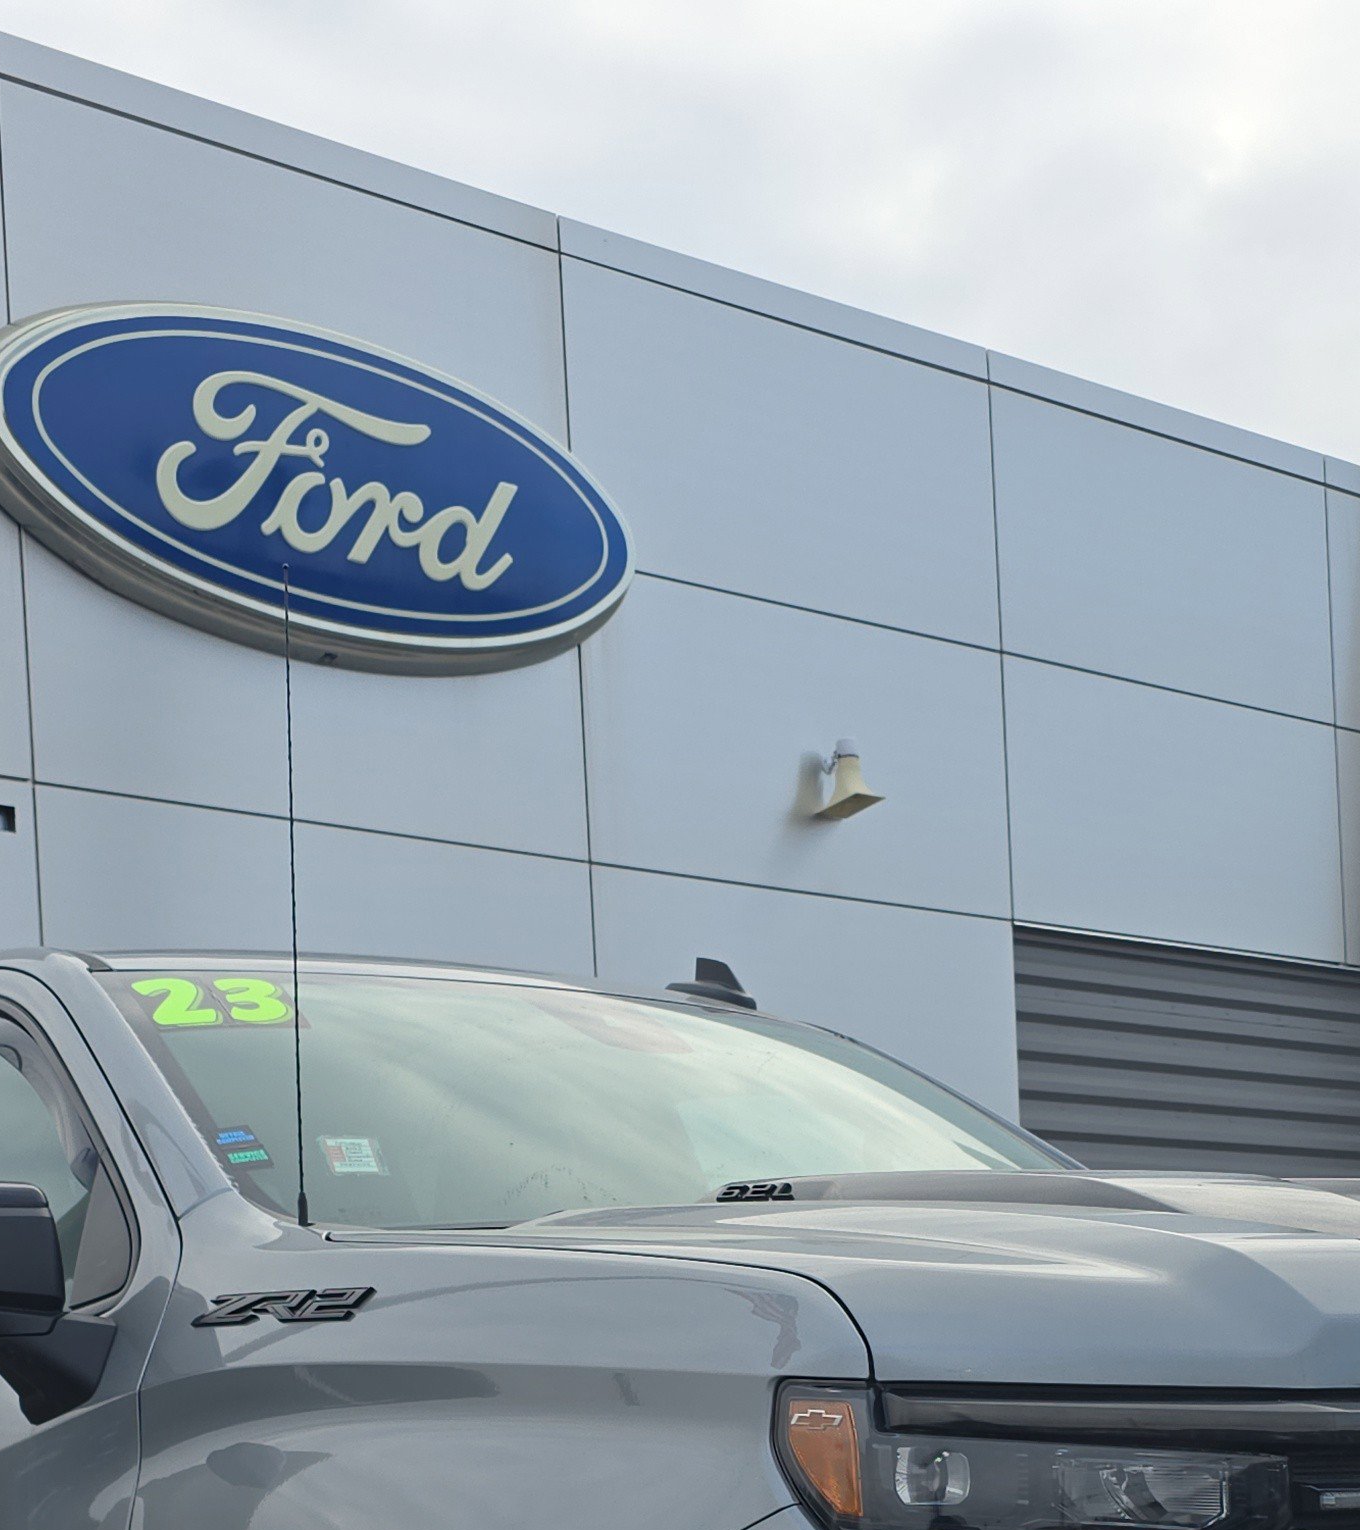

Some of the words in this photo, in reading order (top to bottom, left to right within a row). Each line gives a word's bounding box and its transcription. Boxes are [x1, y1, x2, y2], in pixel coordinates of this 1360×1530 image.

[156, 370, 518, 591] Ford
[131, 978, 293, 1025] 23
[191, 1287, 377, 1328] ZR2
